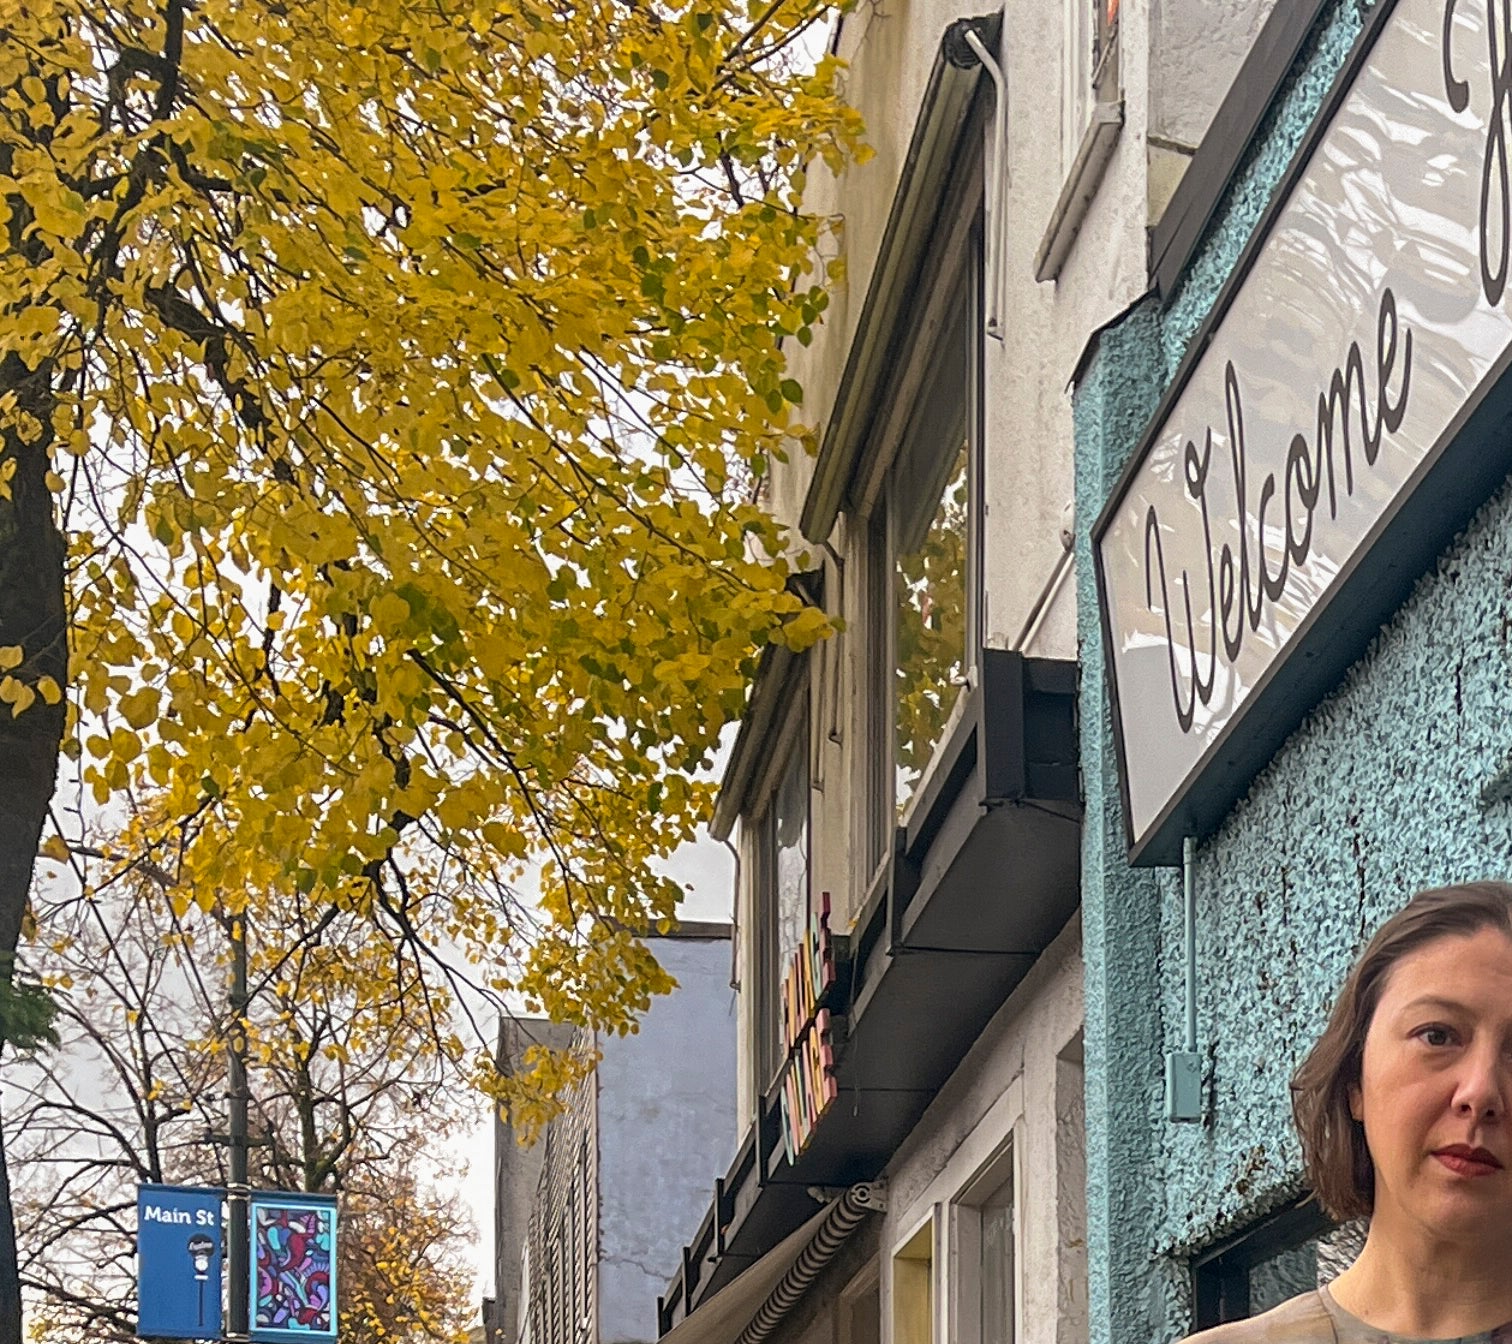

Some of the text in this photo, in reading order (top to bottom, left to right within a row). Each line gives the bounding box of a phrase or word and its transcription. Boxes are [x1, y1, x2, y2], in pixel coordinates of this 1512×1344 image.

[1144, 287, 1412, 732] Welcome
[144, 1205, 215, 1227] Main St
